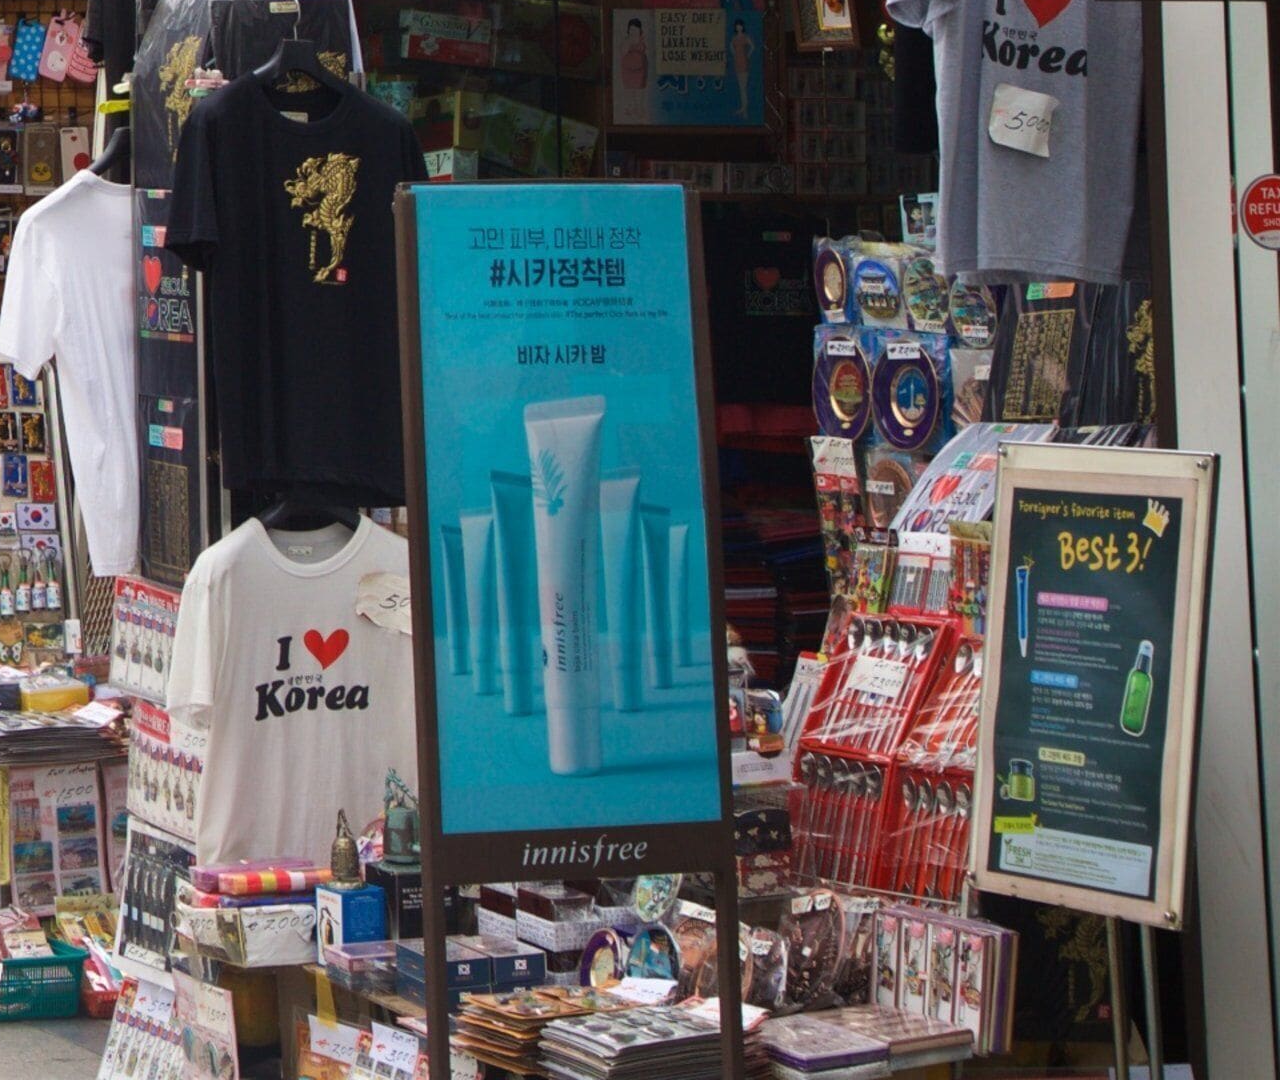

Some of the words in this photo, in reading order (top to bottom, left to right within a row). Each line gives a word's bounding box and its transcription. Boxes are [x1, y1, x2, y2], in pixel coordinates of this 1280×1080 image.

[660, 12, 687, 24] EASY
[660, 26, 684, 36] DIET
[661, 37, 708, 49] LAXATIVE
[662, 51, 687, 62] LOSE
[690, 50, 725, 63] WEIGHT
[981, 20, 1089, 78] Korea
[469, 227, 504, 250] 고민
[509, 227, 549, 251] 피부,
[554, 226, 604, 250] 마침내
[609, 226, 641, 250] 정착
[490, 257, 626, 288] #시카정착템
[518, 344, 550, 366] 비자
[555, 344, 587, 366] 시카
[591, 343, 607, 366] 밤
[1019, 499, 1069, 520] Foreigner's
[1071, 502, 1110, 518] favorite
[1113, 506, 1136, 520] item
[1057, 530, 1121, 571] Best
[1125, 531, 1153, 574] 3!
[555, 592, 567, 673] innisfree
[275, 635, 293, 671] I
[255, 679, 370, 722] Korea
[521, 834, 648, 867] innisfree
